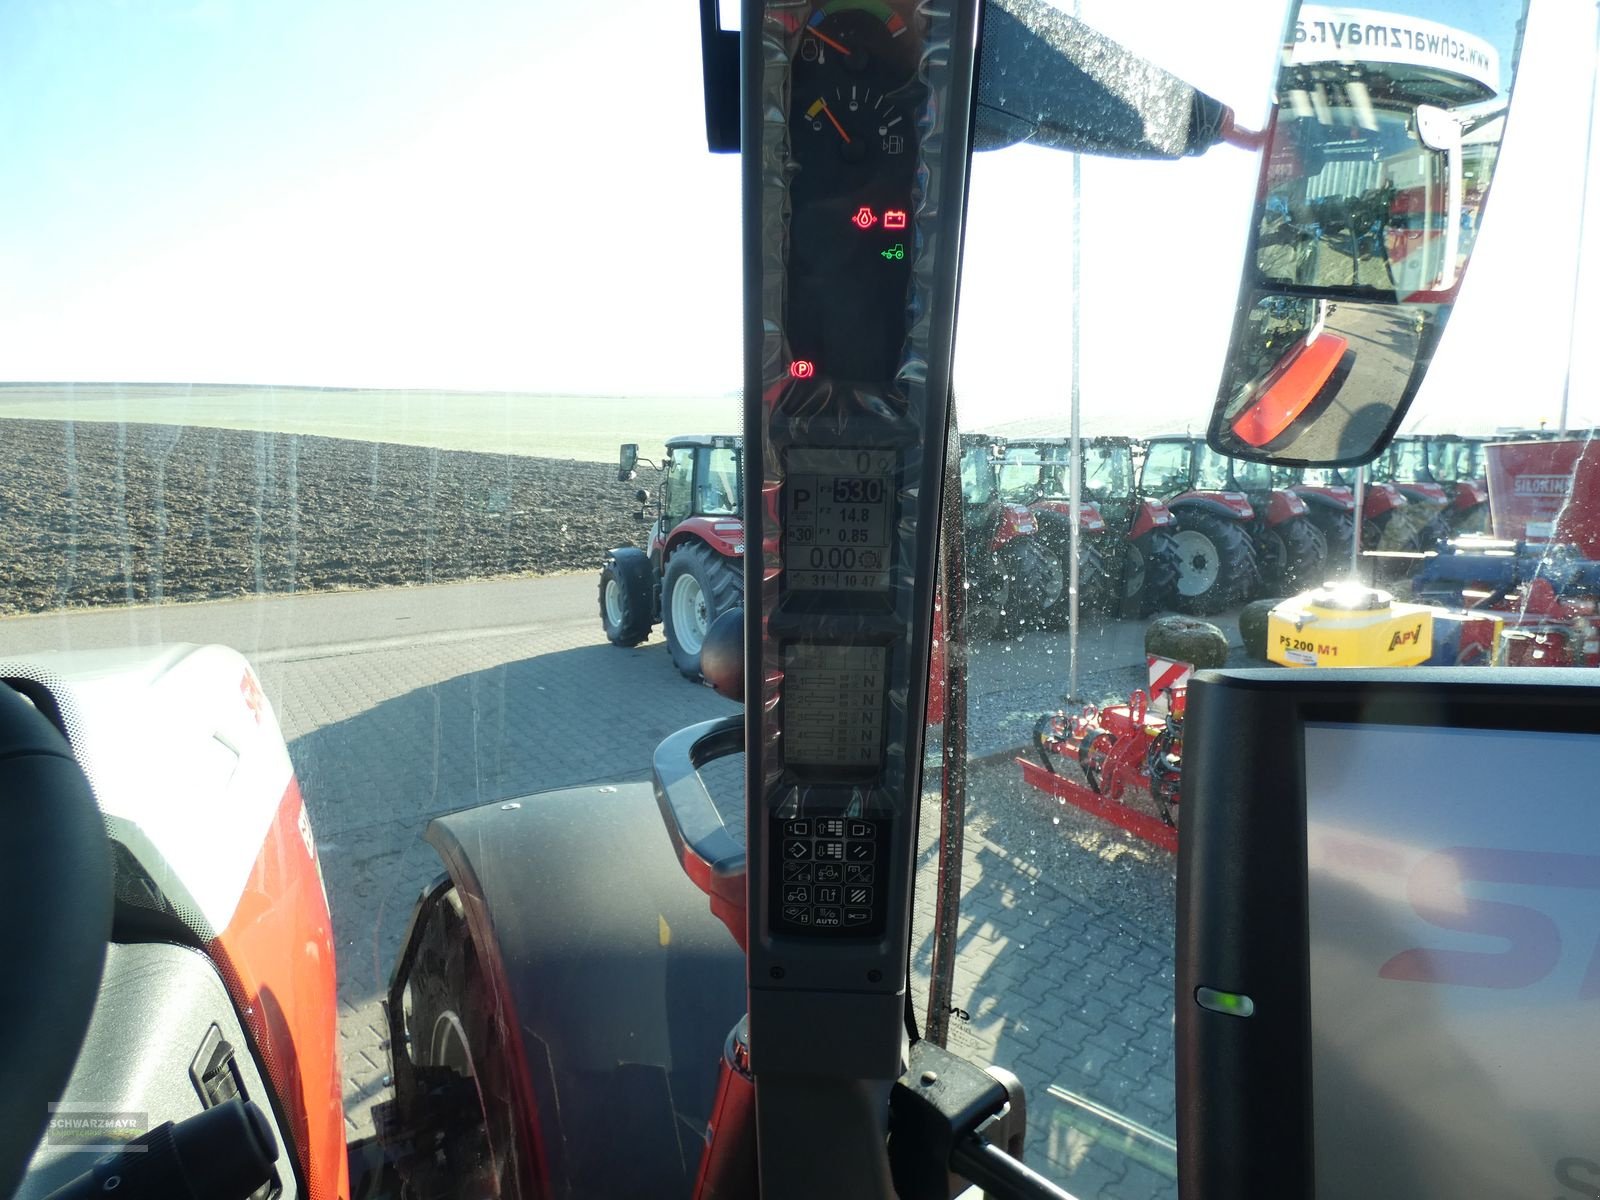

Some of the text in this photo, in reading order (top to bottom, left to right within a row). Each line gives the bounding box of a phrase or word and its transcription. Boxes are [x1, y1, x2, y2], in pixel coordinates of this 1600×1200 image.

[838, 479, 882, 502] 530
[794, 489, 810, 510] P
[840, 508, 869, 523] 14.8
[838, 529, 869, 543] 0.85
[810, 548, 856, 569] 0.00
[1280, 636, 1338, 656] PS 200 M1
[864, 675, 875, 688] N
[864, 694, 874, 706] N
[863, 712, 873, 724] N
[862, 729, 872, 742] N
[861, 747, 871, 760] N
